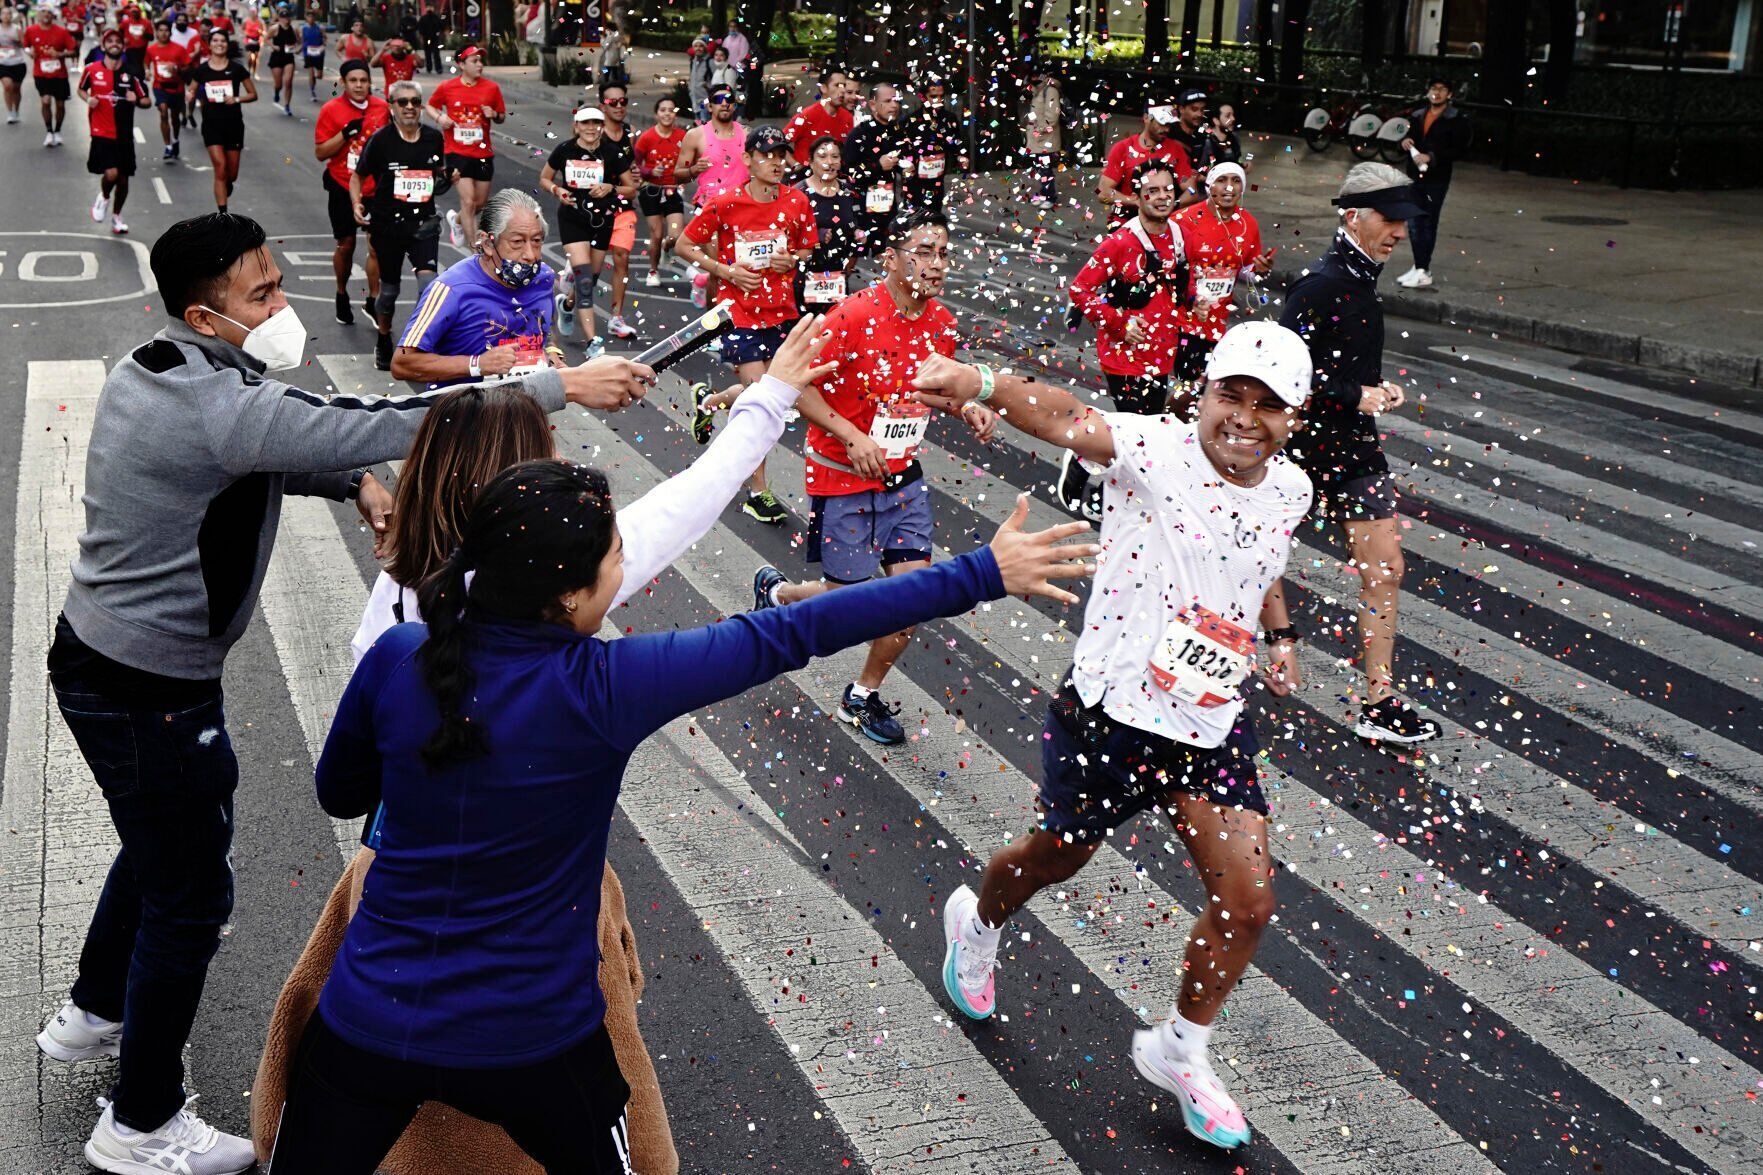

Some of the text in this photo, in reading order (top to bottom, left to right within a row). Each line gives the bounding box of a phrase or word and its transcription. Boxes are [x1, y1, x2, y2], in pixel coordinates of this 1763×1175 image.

[572, 169, 596, 179] 10744
[401, 181, 427, 191] 10753
[0, 251, 99, 282] 0
[884, 422, 918, 439] 10614
